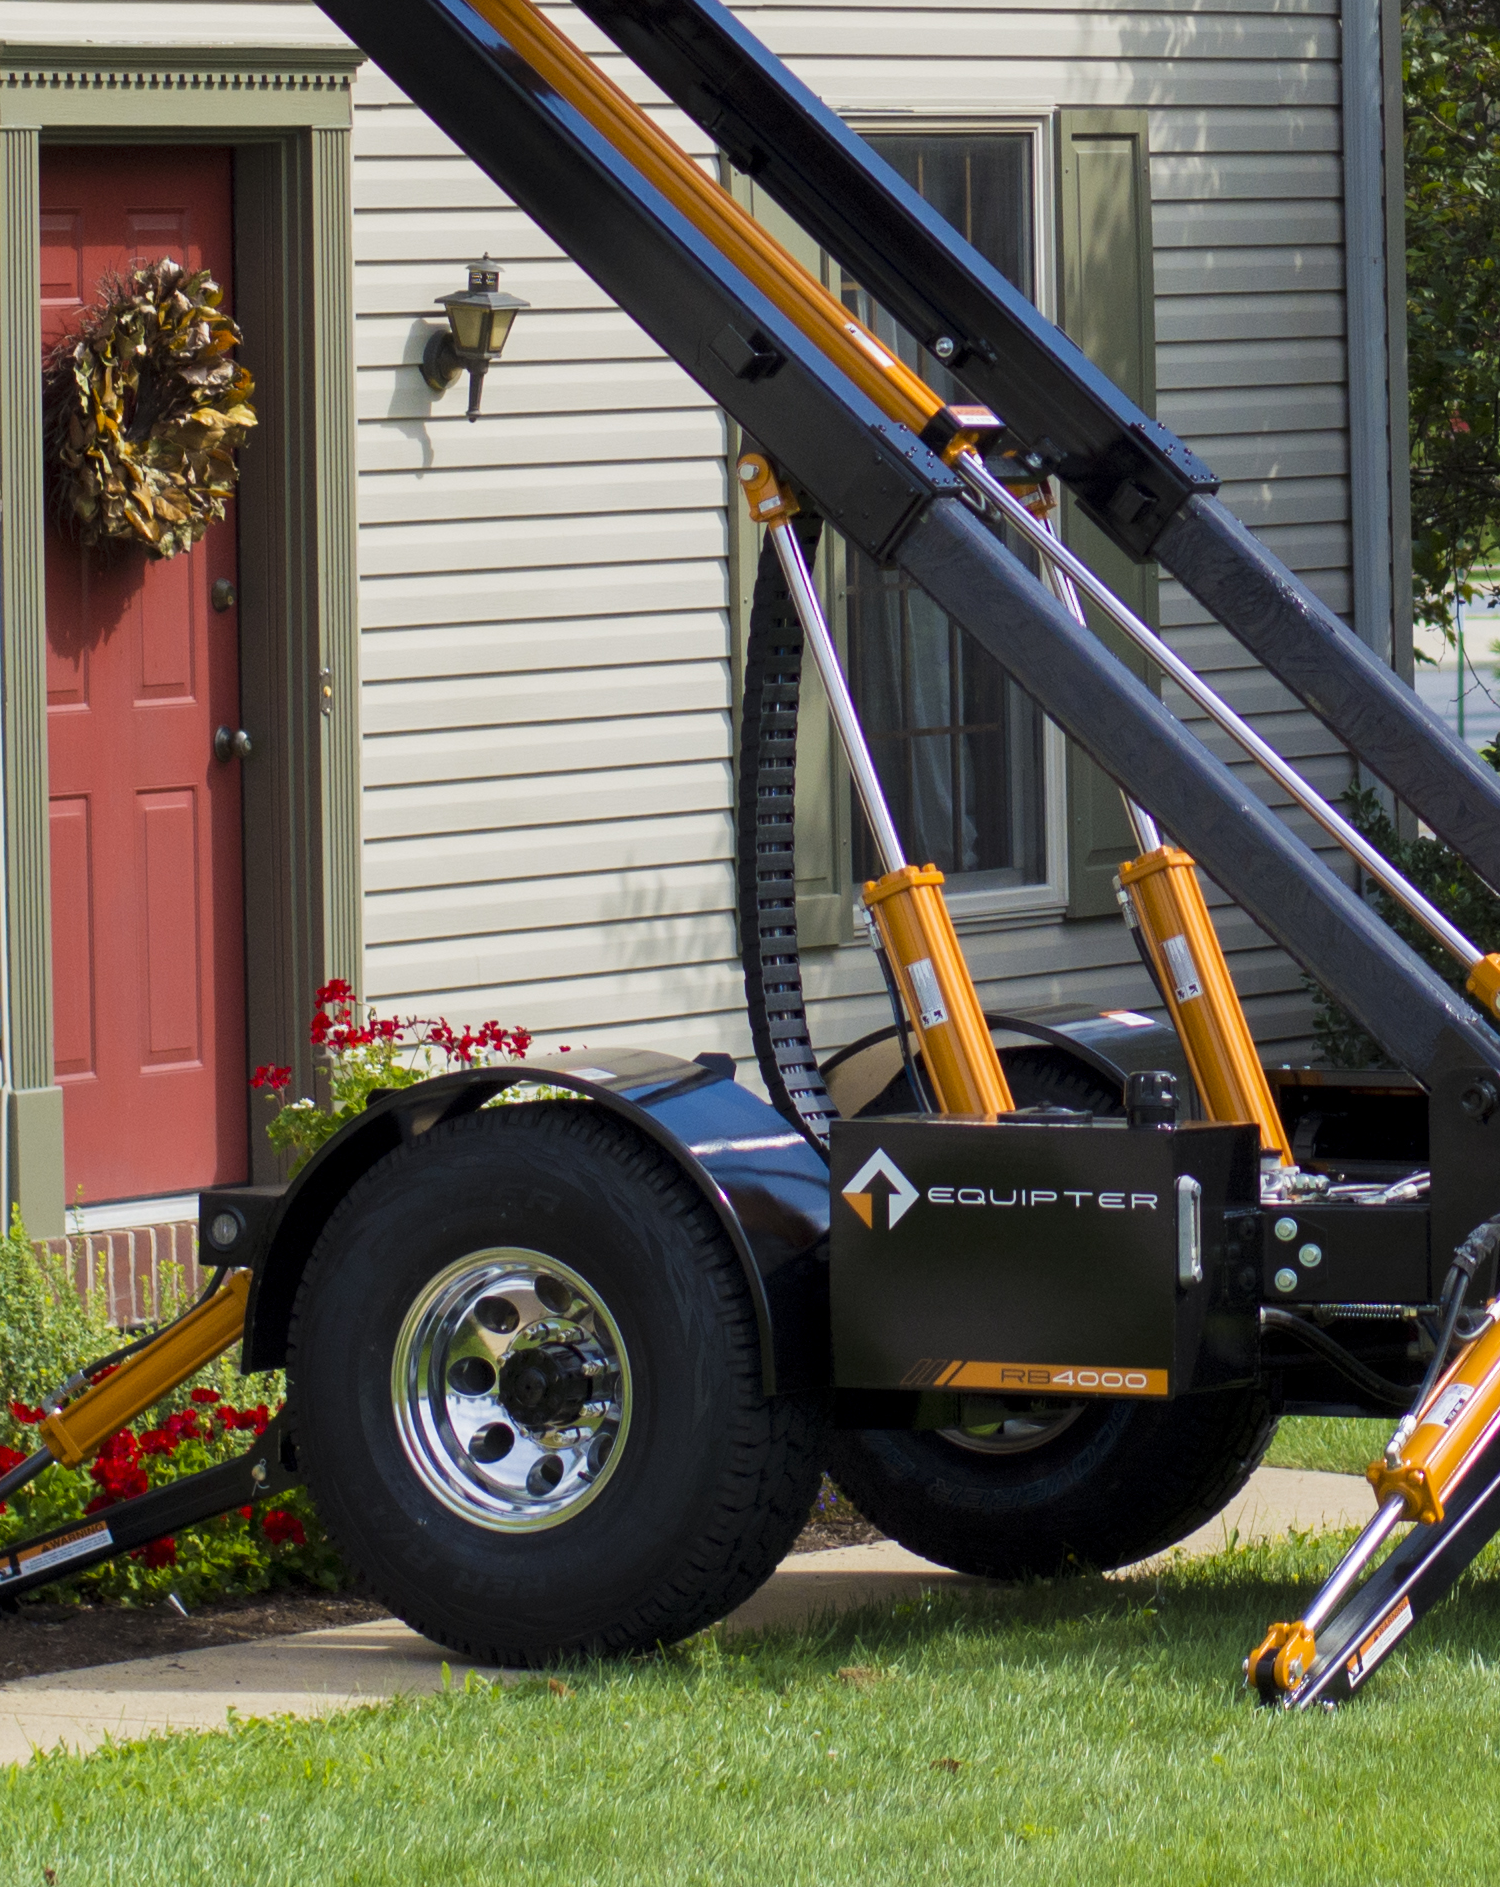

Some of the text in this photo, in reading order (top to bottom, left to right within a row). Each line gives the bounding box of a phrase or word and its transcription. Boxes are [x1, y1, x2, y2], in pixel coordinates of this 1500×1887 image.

[927, 1186, 1158, 1210] EQUIPTER
[1000, 1367, 1148, 1389] RB4000
[50, 1522, 104, 1550] WARNING
